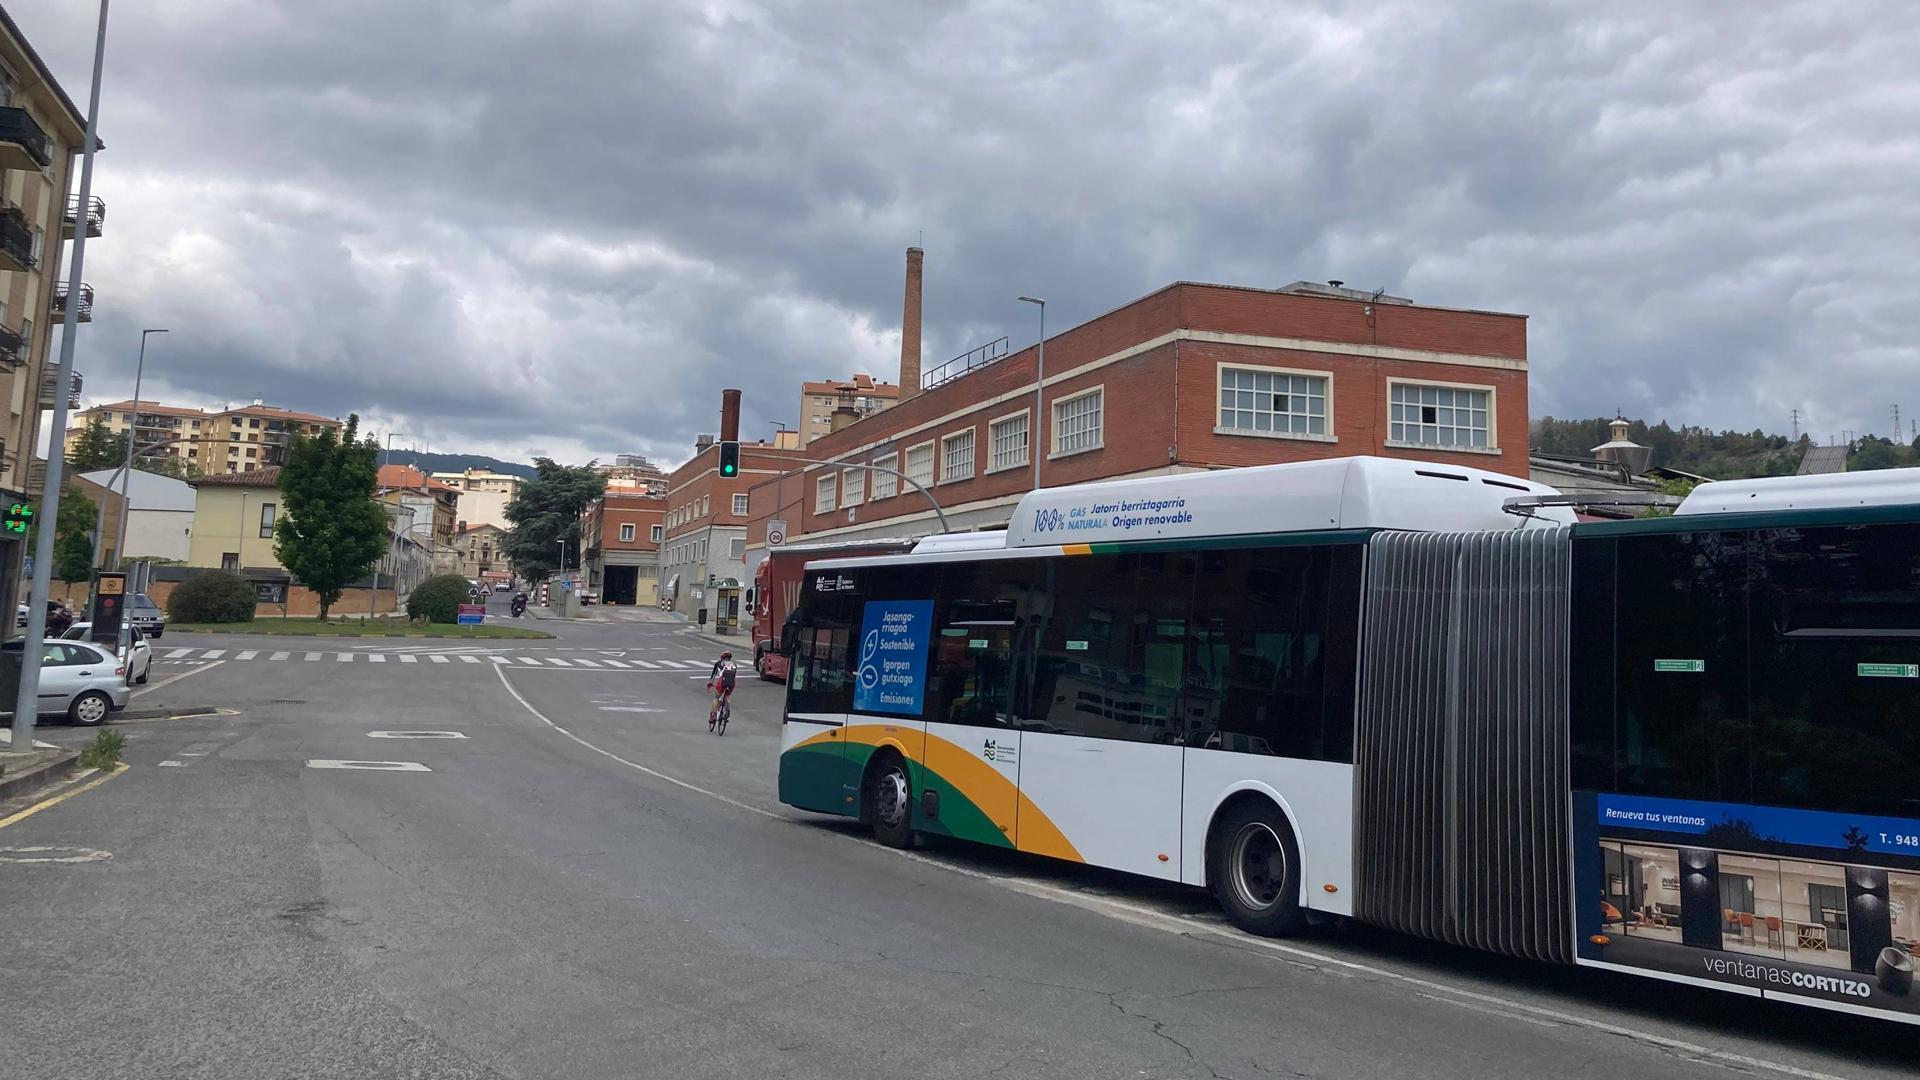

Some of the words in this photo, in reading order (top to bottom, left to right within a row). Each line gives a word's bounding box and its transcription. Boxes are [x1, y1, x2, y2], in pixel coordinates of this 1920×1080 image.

[1070, 507, 1087, 518] GAS
[1090, 502, 1119, 514] Jatorri
[1121, 496, 1185, 512] berriztagarria
[1067, 518, 1107, 530] NATURALA
[1112, 515, 1142, 529] Origen
[1144, 510, 1193, 525] renovable
[880, 638, 915, 650] Sostenible
[883, 658, 910, 673] Igorpen
[881, 671, 913, 686] gutxiago
[880, 692, 913, 706] Emisiones
[1606, 808, 1644, 820] Renueva
[1646, 812, 1661, 822] tus
[1662, 814, 1705, 826] ventanas
[1879, 833, 1892, 845] T.
[1895, 834, 1919, 847] 948
[1703, 956, 1871, 998] ventanasCORTIZO
